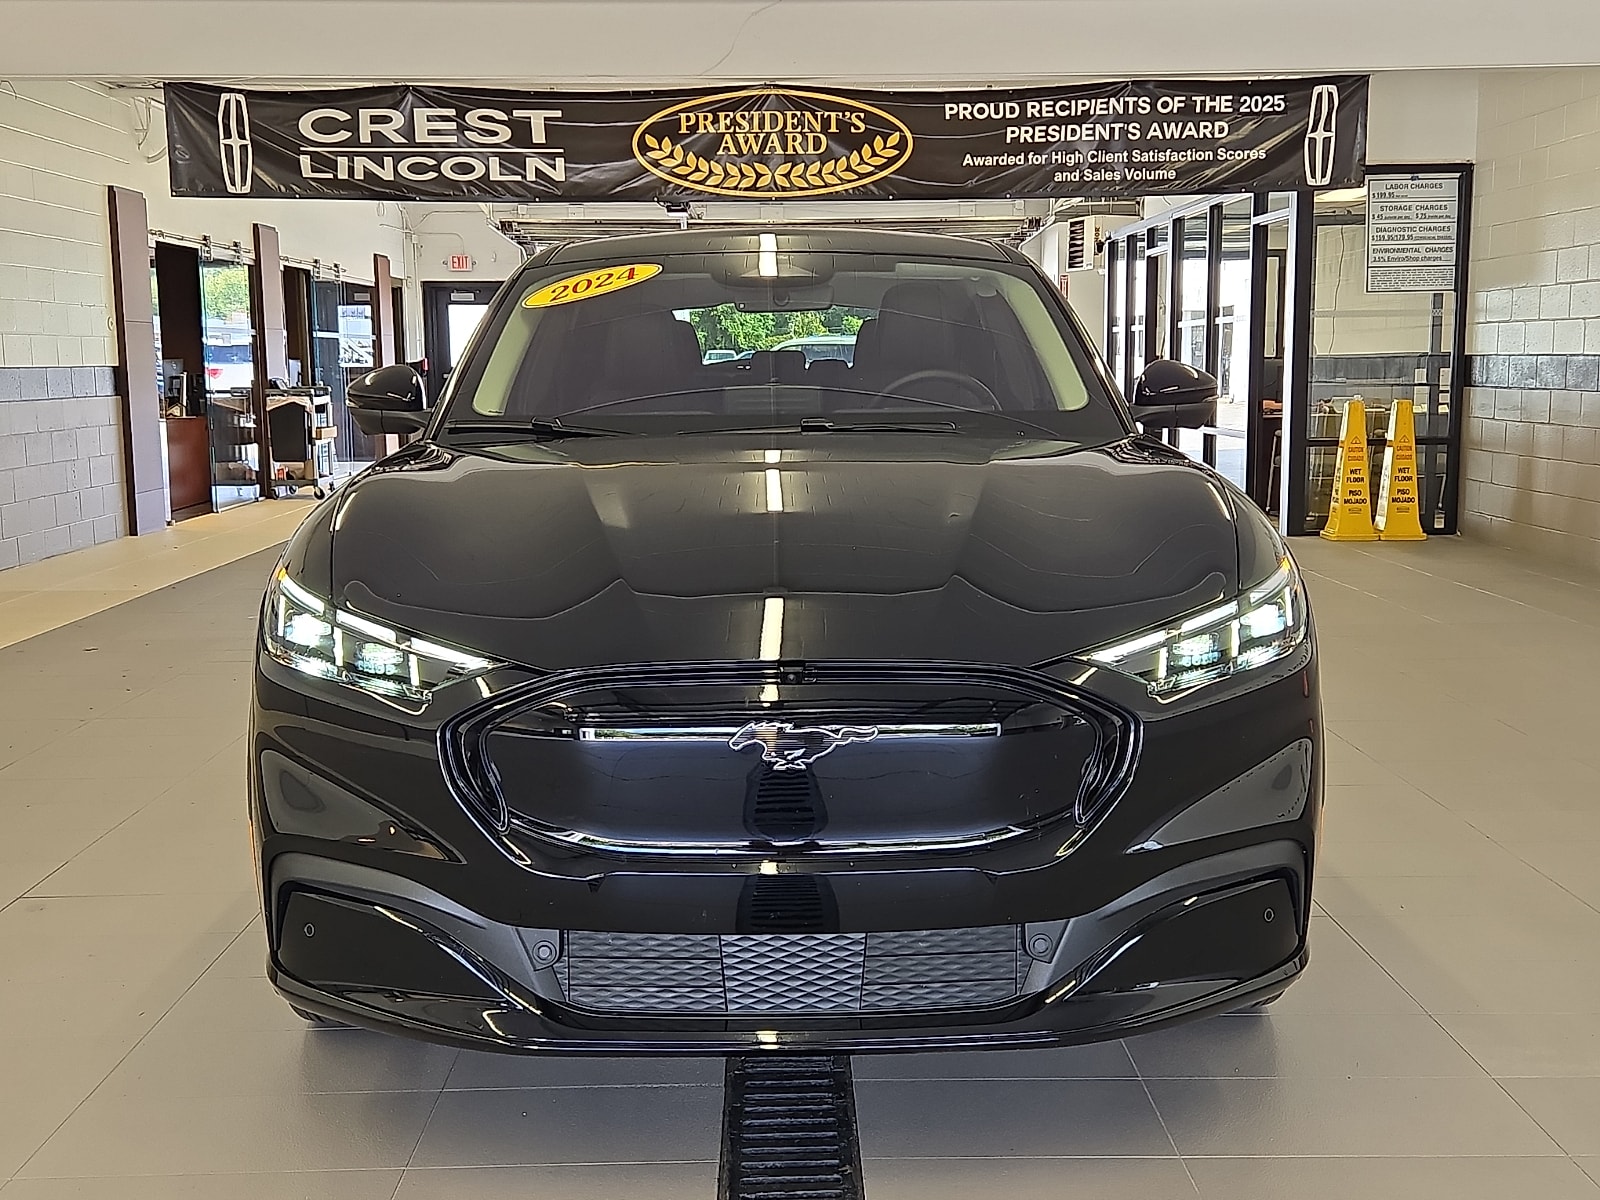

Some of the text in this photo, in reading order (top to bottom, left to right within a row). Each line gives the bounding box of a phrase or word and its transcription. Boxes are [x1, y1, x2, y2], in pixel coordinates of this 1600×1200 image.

[943, 94, 1286, 120] PROUD RECIPIENTS OF THE 2025
[298, 108, 562, 144] CREST
[677, 110, 867, 134] PRESIDENT'S
[1005, 121, 1229, 144] PRESIDENT'S AWARD
[716, 132, 828, 155] AWARD
[299, 154, 566, 182] LINCOLN
[962, 147, 1267, 167] Awarded for High Client Satisfaction Scores
[1053, 168, 1177, 182] and Sales Volume
[451, 255, 469, 269] EXIT
[550, 267, 639, 302] 2024
